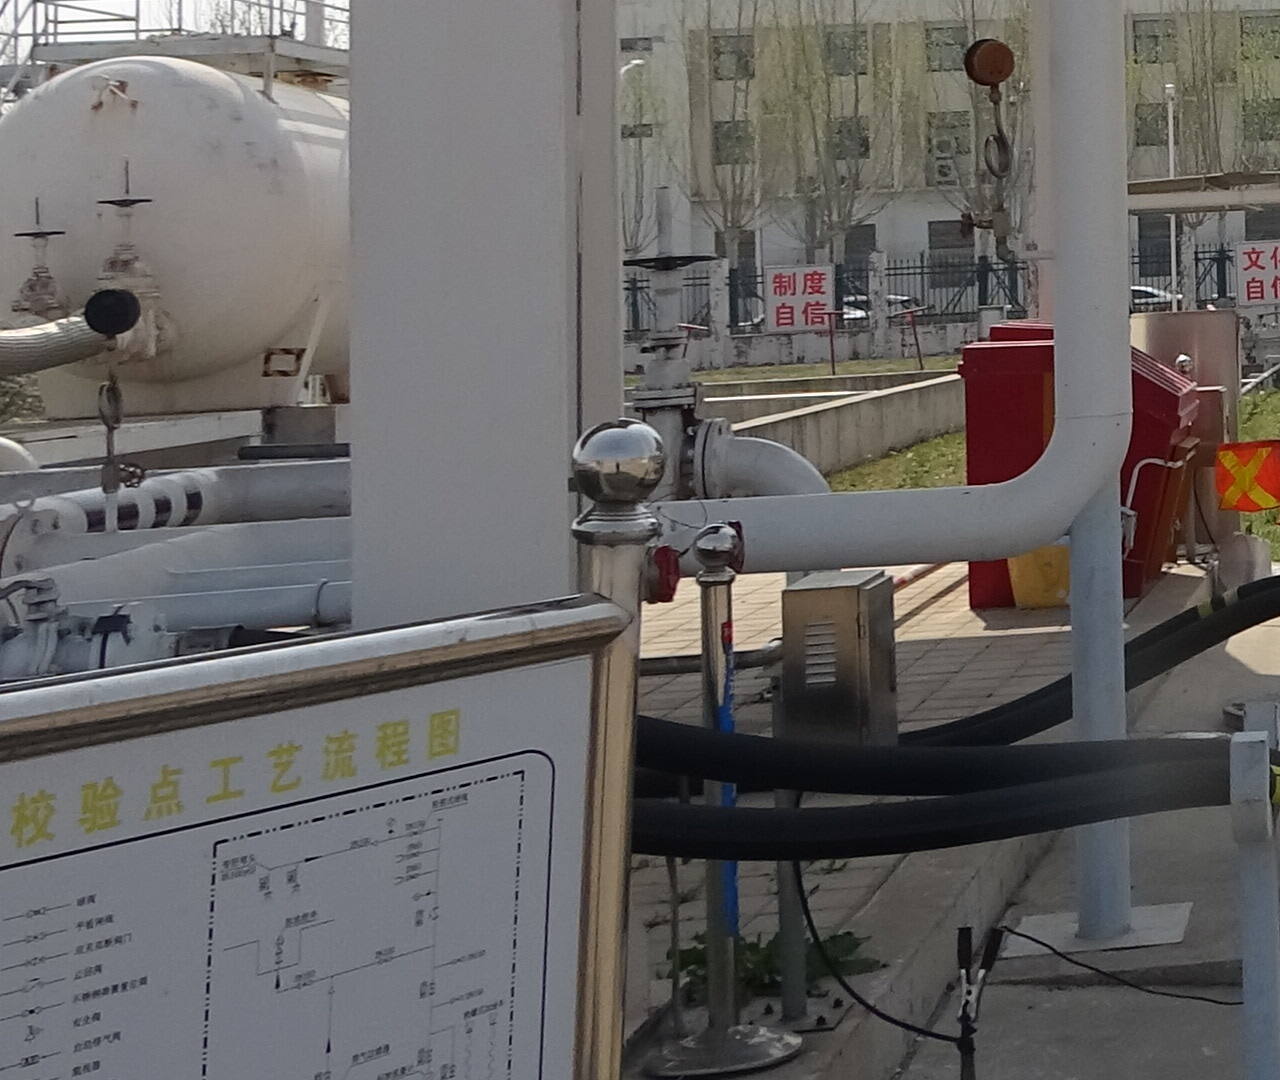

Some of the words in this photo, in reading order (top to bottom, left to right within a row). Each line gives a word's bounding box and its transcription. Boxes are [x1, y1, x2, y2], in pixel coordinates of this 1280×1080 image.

[772, 270, 827, 296] 制度
[775, 301, 827, 327] 自信
[12, 709, 461, 848] 校验点工艺流程图
